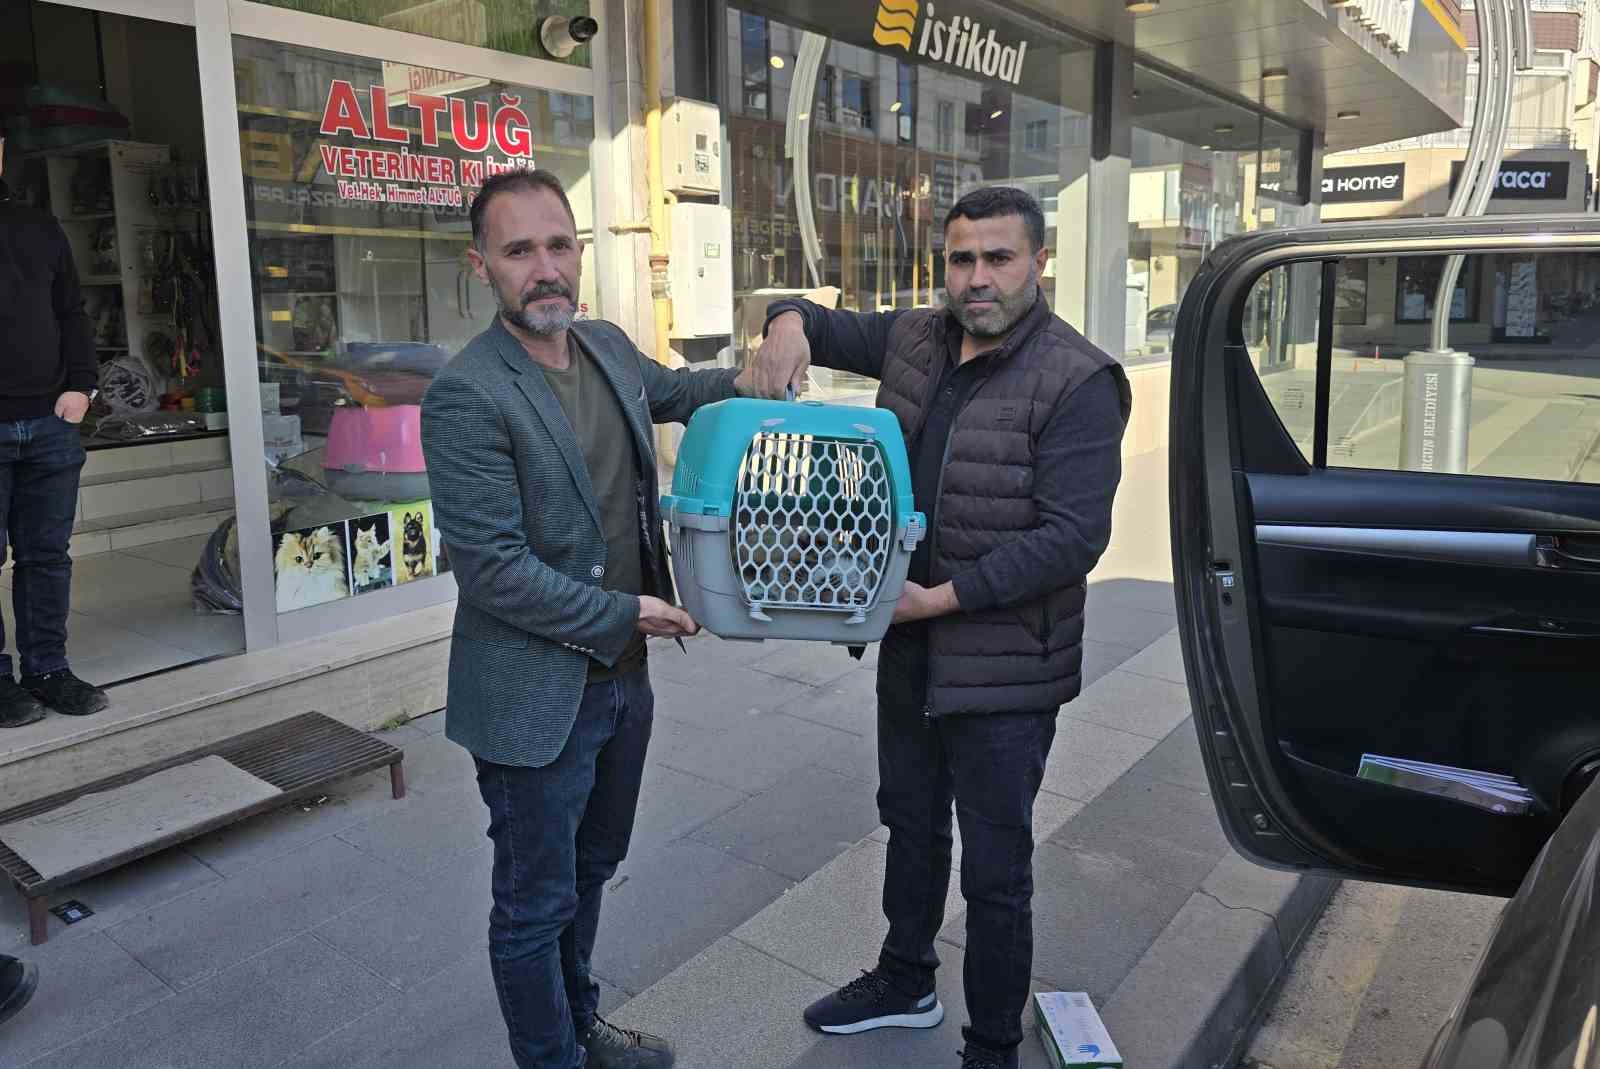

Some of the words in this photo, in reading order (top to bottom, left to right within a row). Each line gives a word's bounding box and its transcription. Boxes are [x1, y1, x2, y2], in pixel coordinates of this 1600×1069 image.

[918, 2, 1028, 85] istikbal
[319, 79, 533, 158] ALTUĞ
[319, 145, 456, 186] VETERİNER
[1494, 170, 1546, 189] raca
[386, 183, 428, 205] Himmet
[427, 187, 463, 207] ALTUĞ
